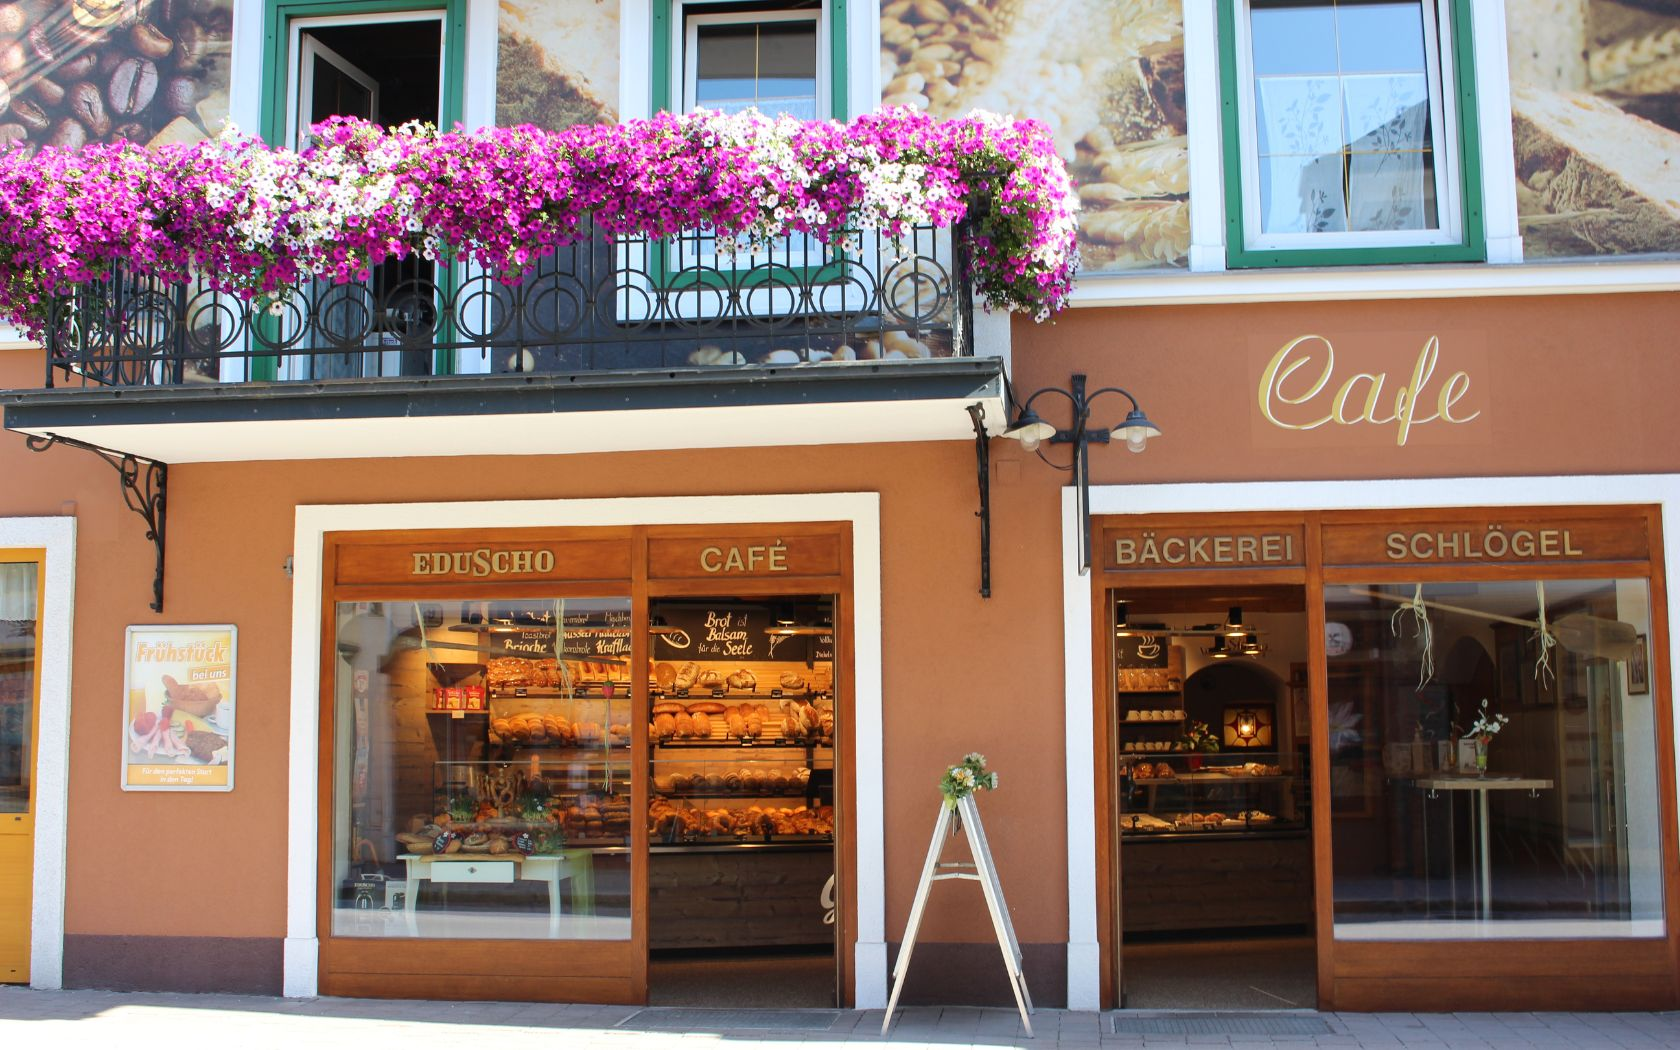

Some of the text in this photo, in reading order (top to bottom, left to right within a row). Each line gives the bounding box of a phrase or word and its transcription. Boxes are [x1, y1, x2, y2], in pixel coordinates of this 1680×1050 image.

[1258, 334, 1480, 446] Cafe
[1115, 524, 1583, 565] BÄCKEREI SCHLÖGEL
[700, 538, 788, 573] CAFÉ
[704, 610, 748, 628] Brot ist
[706, 628, 748, 642] Balsam
[135, 641, 227, 663] Frühstück
[503, 638, 548, 653] Brioche
[698, 640, 753, 656] für die Seele
[192, 669, 227, 680] bei uns
[142, 767, 152, 775] Für
[196, 767, 212, 775] Start
